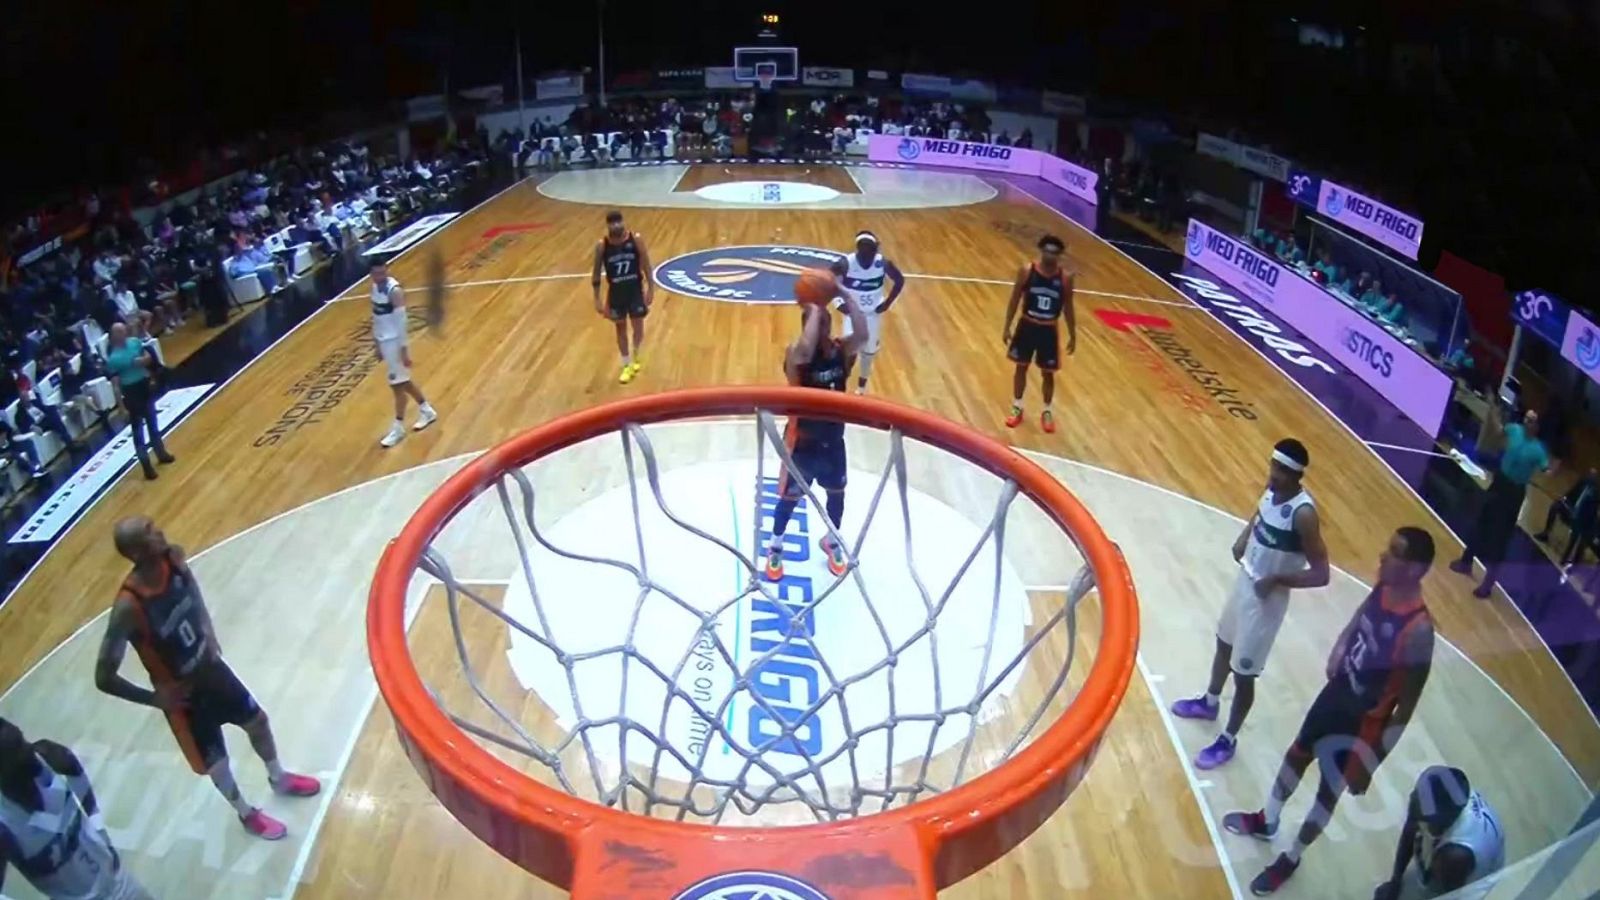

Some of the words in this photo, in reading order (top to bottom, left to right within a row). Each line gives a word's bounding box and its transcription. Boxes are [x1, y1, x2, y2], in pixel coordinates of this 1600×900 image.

[922, 139, 959, 156] MED
[961, 142, 1012, 160] FRIGO
[1344, 194, 1373, 222] MED
[1375, 206, 1419, 241] FRIGO
[615, 260, 631, 275] 77
[1206, 230, 1235, 262] MED
[1236, 247, 1280, 289] FRIGO
[859, 294, 873, 306] 55
[1037, 295, 1051, 310] 10
[1171, 271, 1336, 374] PATRAS
[178, 618, 197, 648] 0
[747, 571, 823, 757] FRIGO
[693, 677, 713, 702] on
